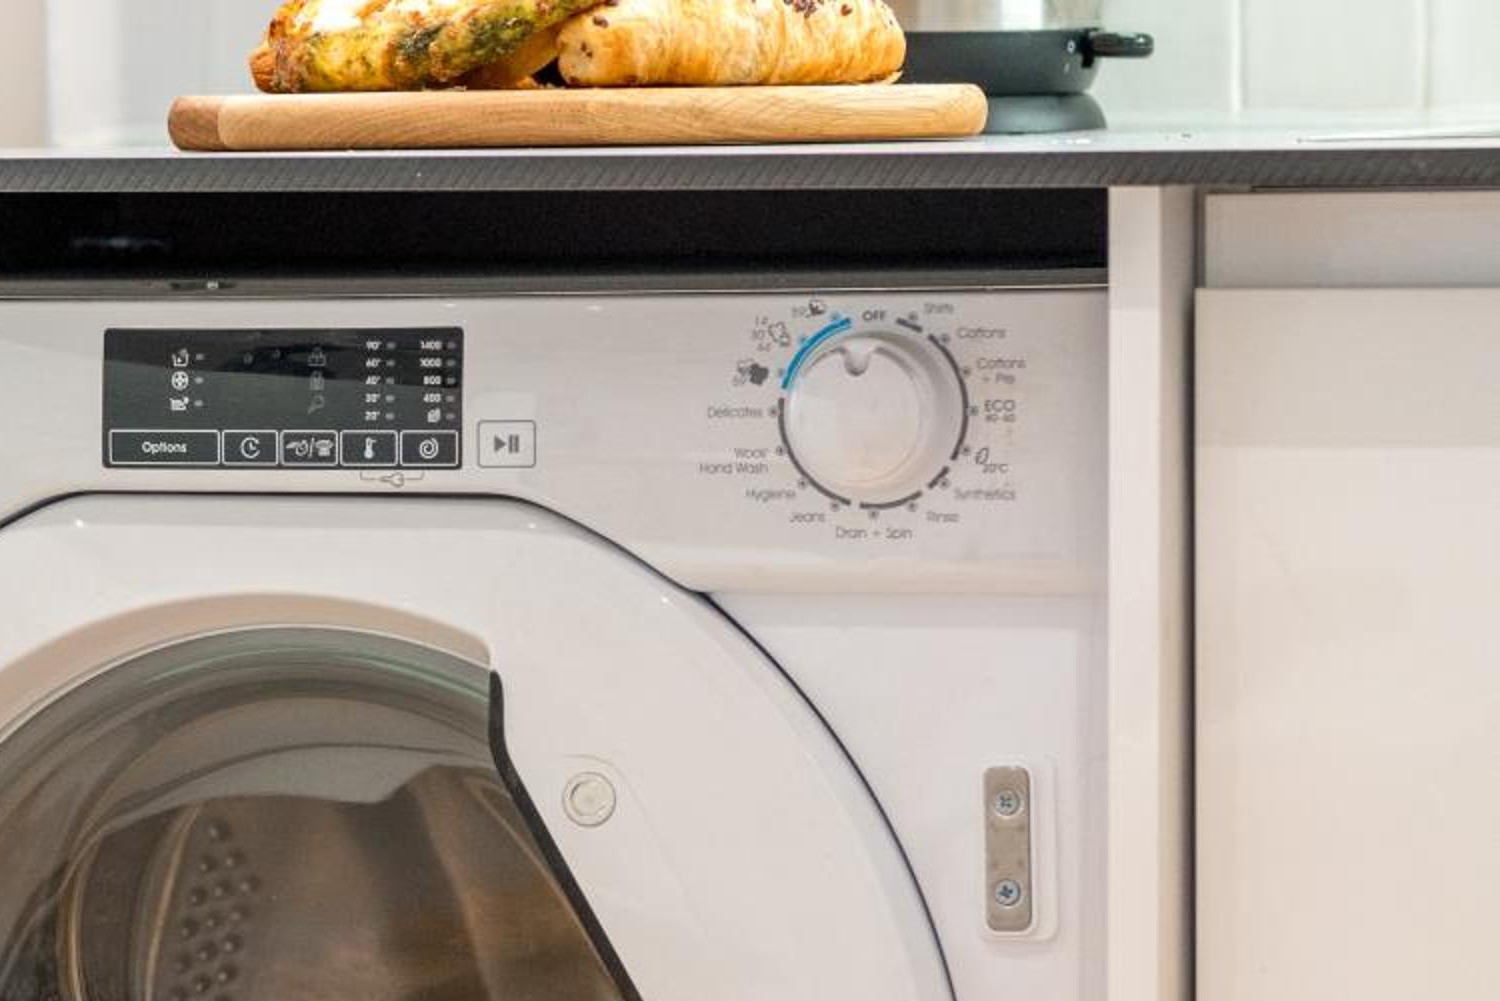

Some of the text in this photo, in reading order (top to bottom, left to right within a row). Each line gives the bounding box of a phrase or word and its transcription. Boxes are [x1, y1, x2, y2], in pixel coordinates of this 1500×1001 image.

[862, 310, 886, 322] OFF
[957, 327, 1006, 339] Cottons
[976, 357, 1027, 368] Cottons
[984, 399, 1016, 412] ECO
[707, 406, 763, 418] Delicates
[141, 440, 188, 455] Options
[699, 462, 769, 474] Hand Wash
[745, 488, 796, 503] Hygiene
[954, 488, 1016, 501] Synthetics
[789, 511, 825, 523] Jeans
[835, 526, 868, 539] Drain
[886, 526, 913, 540] Spin
